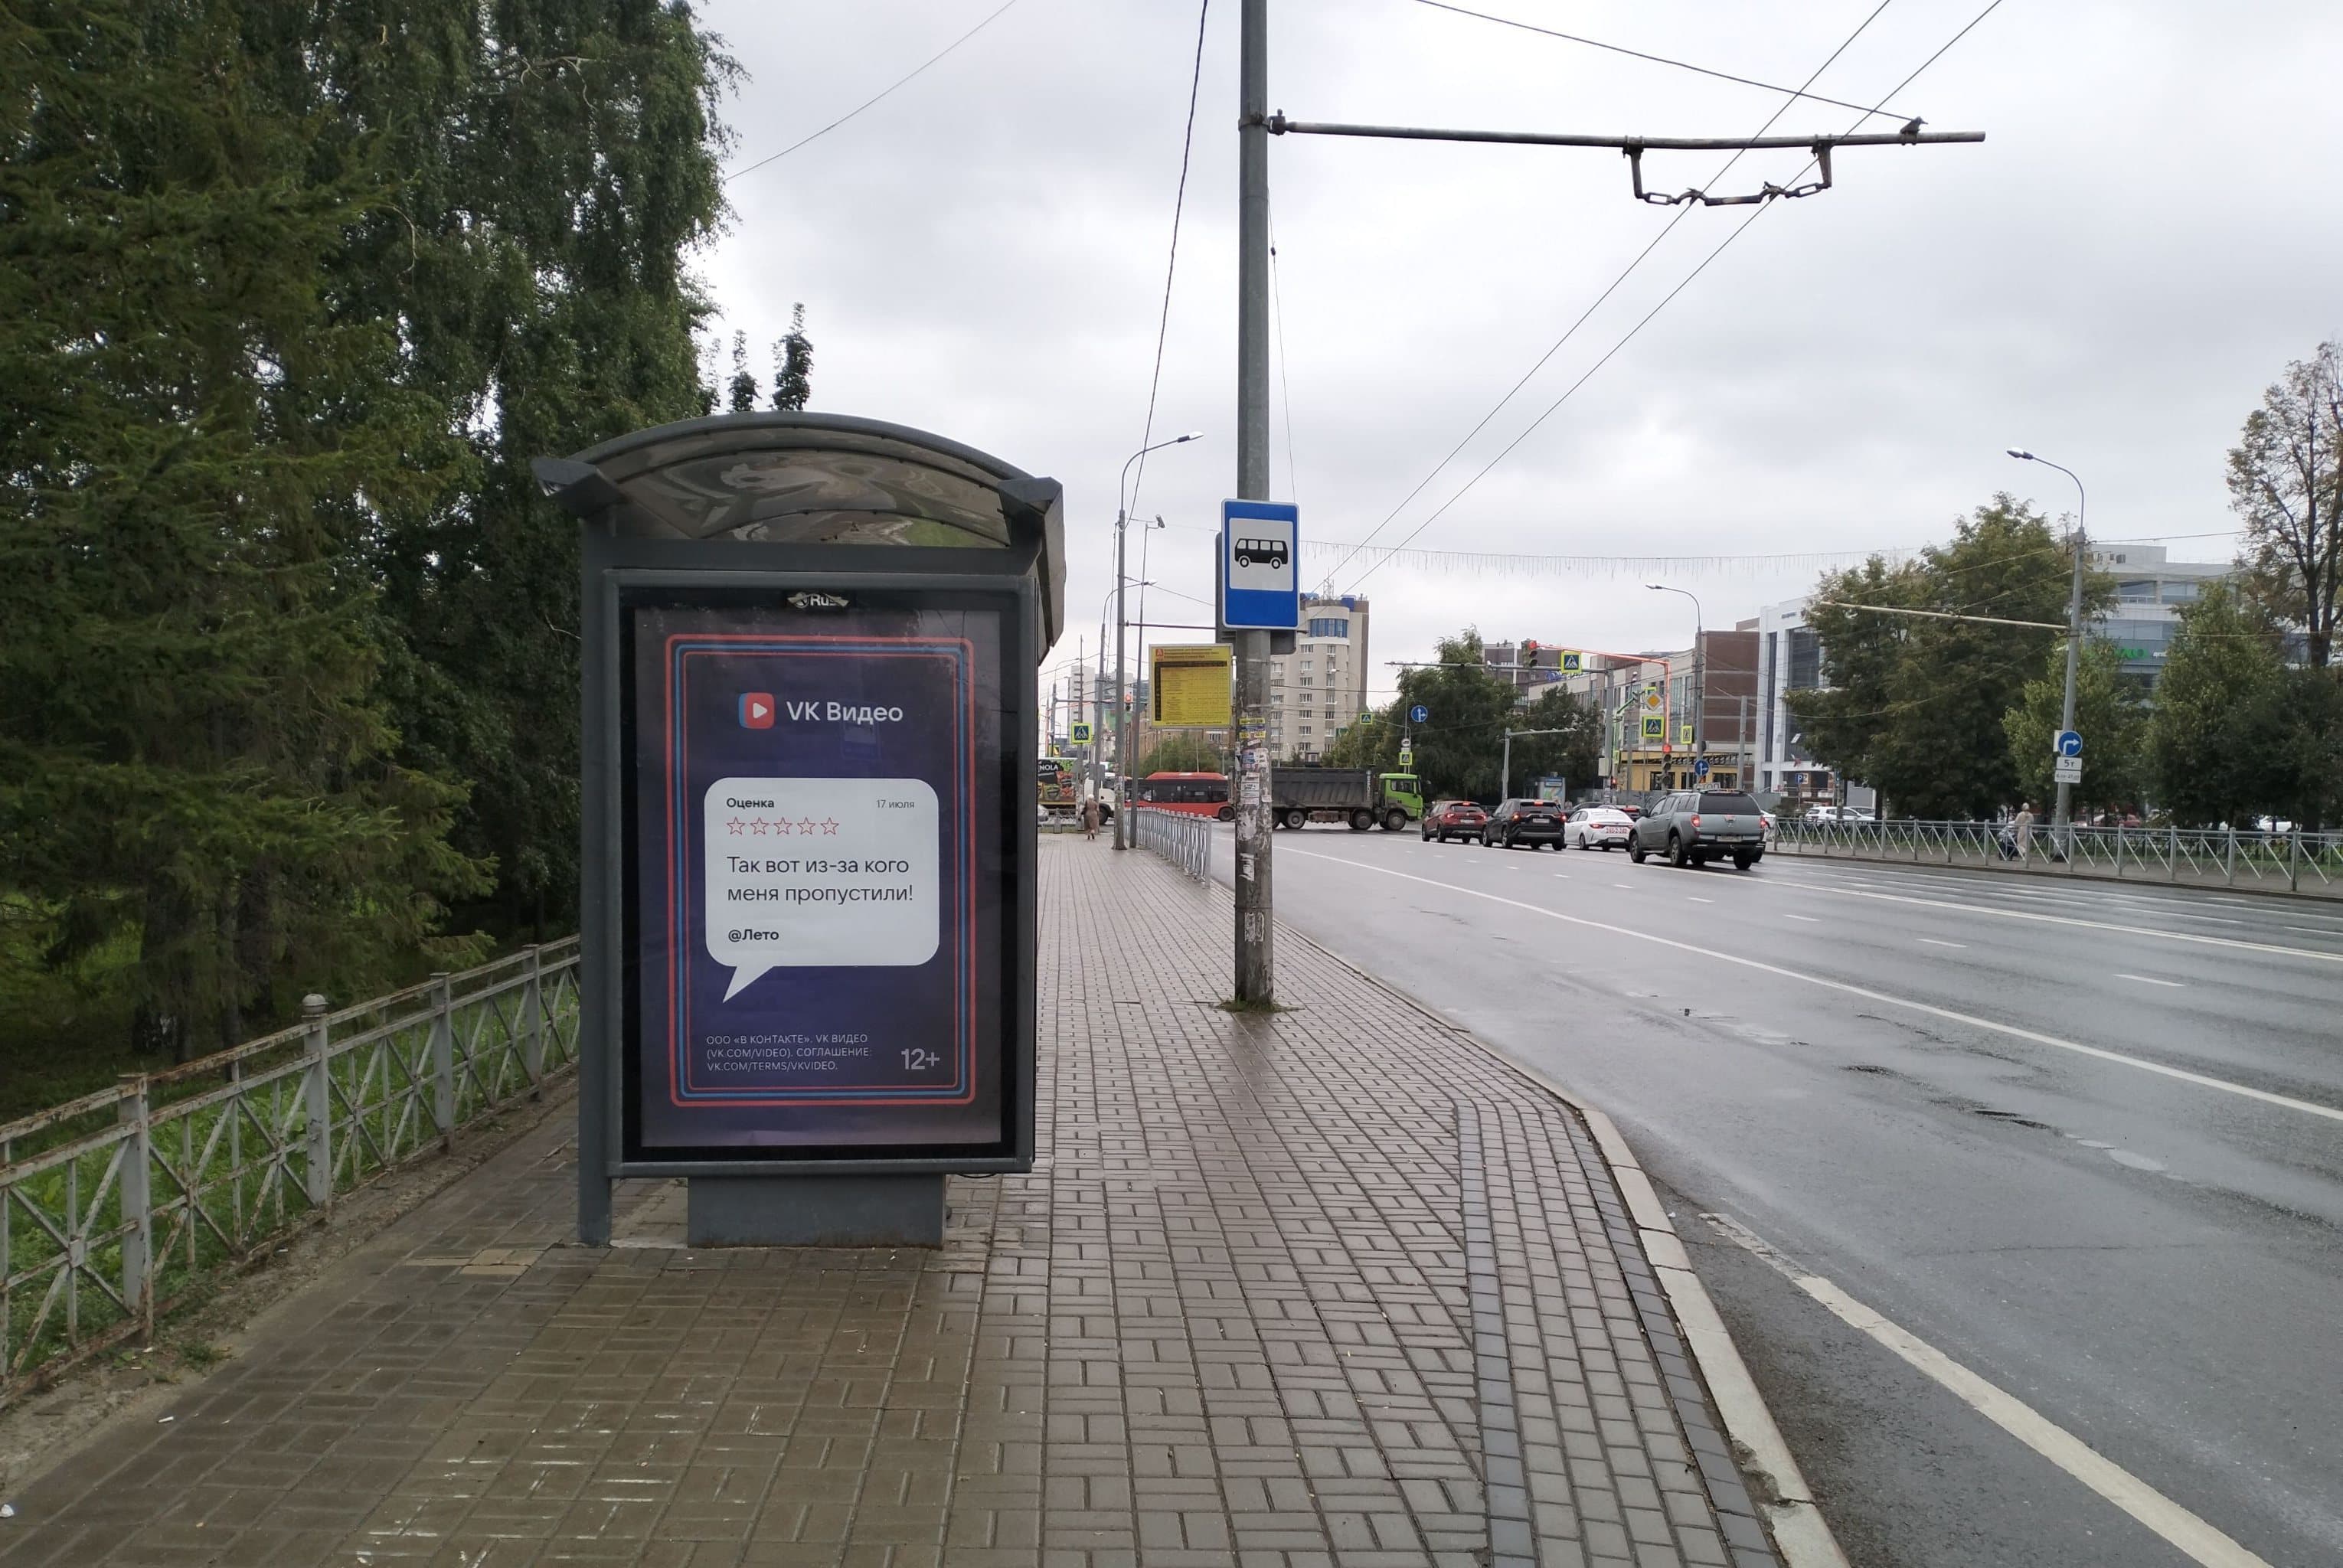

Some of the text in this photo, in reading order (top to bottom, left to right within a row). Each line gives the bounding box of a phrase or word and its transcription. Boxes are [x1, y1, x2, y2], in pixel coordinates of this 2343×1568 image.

[786, 701, 904, 725] VK Видео
[726, 798, 775, 810] Оценка
[876, 799, 886, 808] 17
[727, 857, 910, 873] Так вот из-за кого
[727, 885, 913, 906] меня пропустили!
[727, 929, 779, 942] @Лето
[707, 1035, 730, 1045] ООО
[816, 1034, 829, 1044] VK
[832, 1034, 868, 1045] ВИДЕО
[900, 1048, 940, 1070] 12+
[707, 1060, 838, 1072] VK.COM/TERMS/VKVIDEO.
